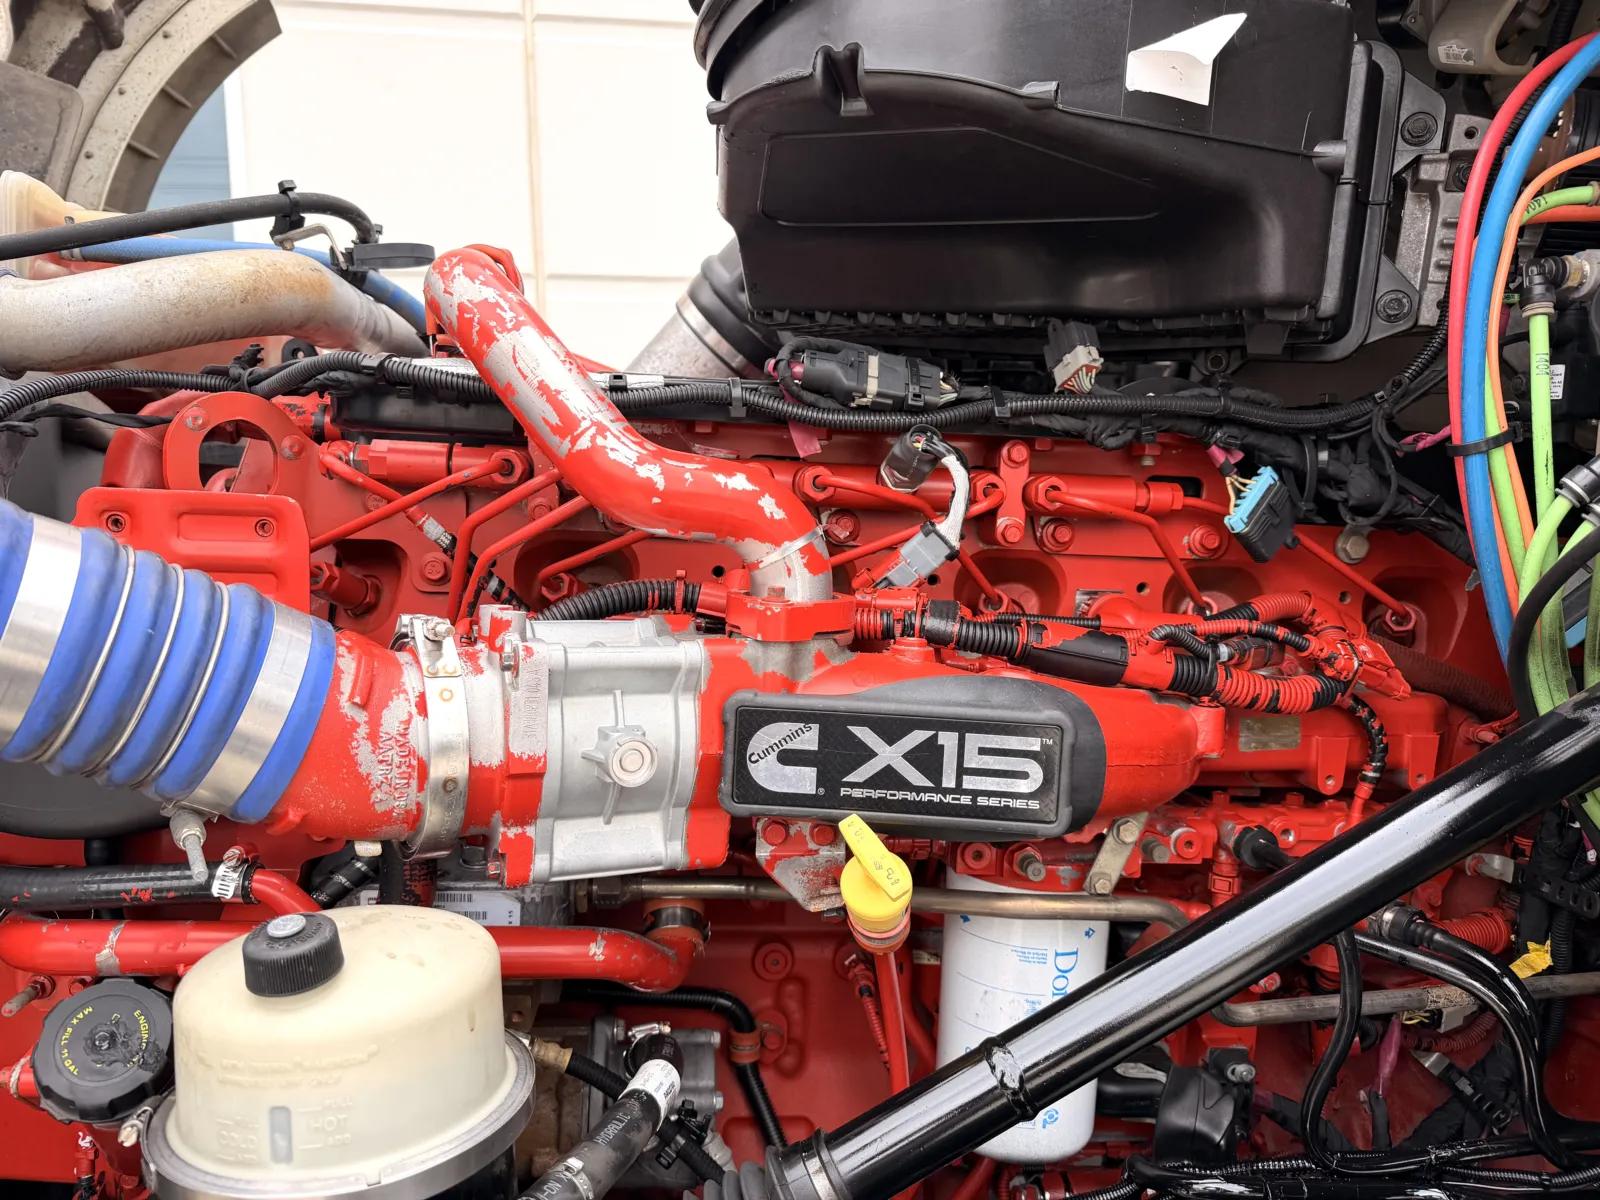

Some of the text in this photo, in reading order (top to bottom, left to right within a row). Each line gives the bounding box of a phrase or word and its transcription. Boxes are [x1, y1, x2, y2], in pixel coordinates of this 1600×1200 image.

[748, 721, 812, 764] Cummins
[842, 725, 1044, 793] X15
[840, 787, 1040, 809] PERFORMANCE SERIES
[71, 1006, 93, 1025] MAX
[61, 1027, 73, 1046] FILL
[63, 1058, 80, 1076] GAL
[592, 1112, 631, 1146] HYDRAULIC
